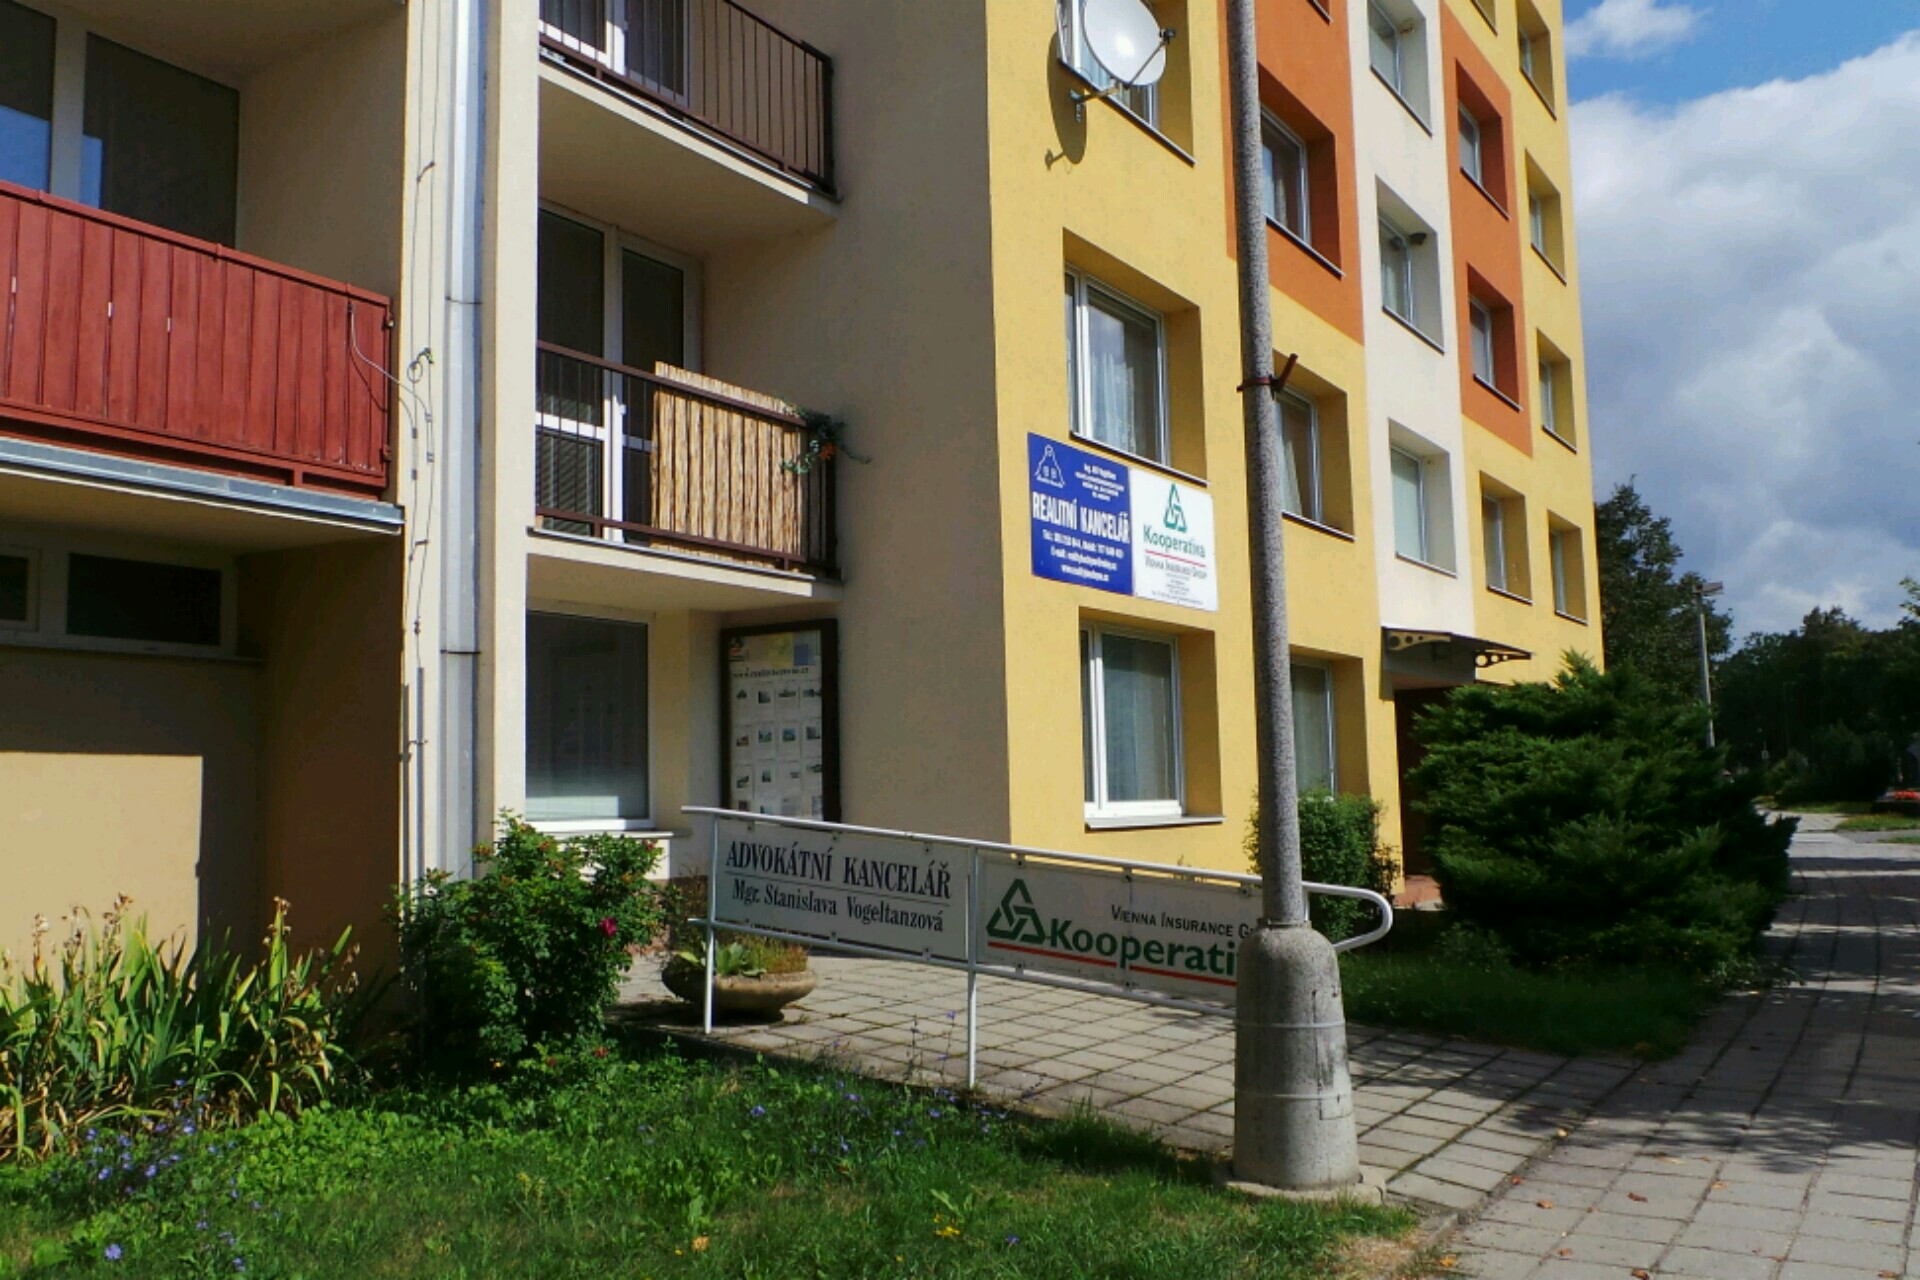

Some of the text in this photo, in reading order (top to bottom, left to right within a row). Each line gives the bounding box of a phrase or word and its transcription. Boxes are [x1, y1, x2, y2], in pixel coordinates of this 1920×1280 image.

[1031, 491, 1130, 544] REALITNÍ KANCELÁŘ
[1143, 524, 1206, 558] Kooperativa
[725, 841, 952, 899] ADVOKÁTNÍ KANCELÁŘ
[732, 878, 944, 932] Mgr. Stanislava Vogeltanzová
[1111, 904, 1254, 940] VIENNA INSURANCE G
[1050, 918, 1238, 976] Kooperati
